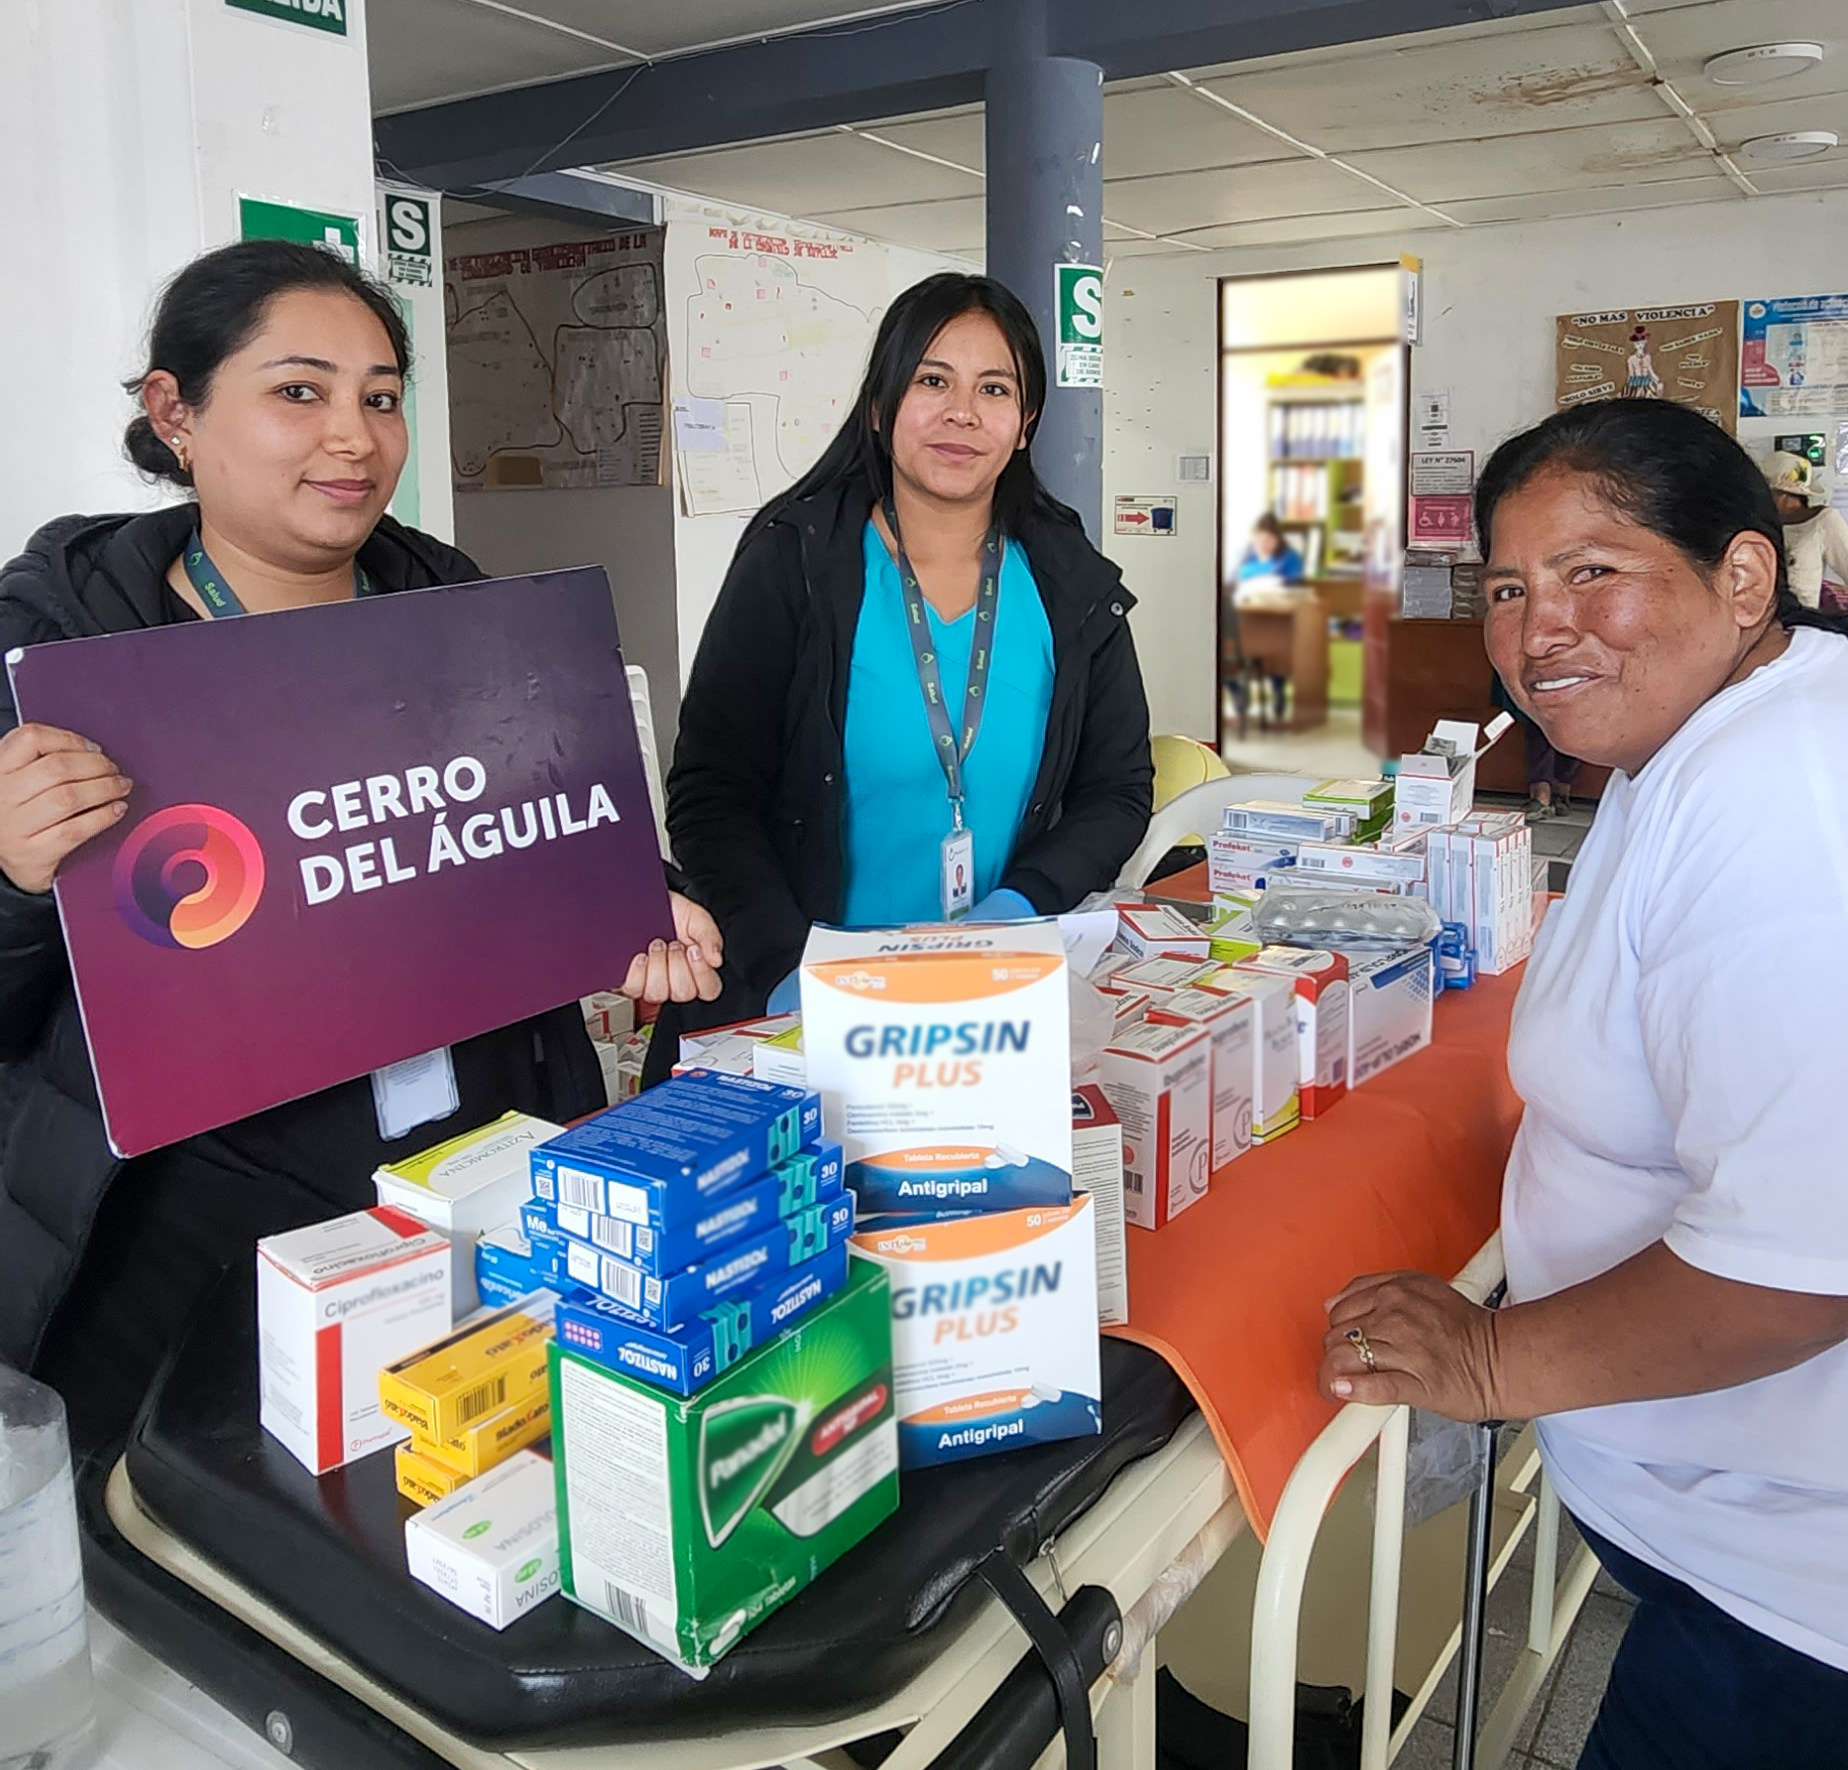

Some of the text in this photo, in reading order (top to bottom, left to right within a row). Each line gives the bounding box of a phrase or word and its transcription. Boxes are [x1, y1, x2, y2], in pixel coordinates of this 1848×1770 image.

[391, 201, 425, 250] S
[1071, 276, 1102, 338] S
[1600, 312, 1626, 324] MAS
[287, 756, 486, 838] CERRO
[300, 783, 620, 905] DEL ÁGUILA
[878, 940, 994, 952] GRIPSIN
[992, 969, 1008, 981] 50
[844, 1020, 1030, 1058] GRIPSIN
[893, 1060, 982, 1088] PLUS
[780, 1089, 804, 1099] 30
[803, 1107, 818, 1125] 30
[821, 1161, 838, 1179] 30
[903, 1153, 934, 1162] Tableta
[898, 1178, 988, 1198] Antigripal
[696, 1198, 758, 1239] NASTIZOL
[832, 1207, 848, 1226] 30
[1026, 1213, 1042, 1227] 50
[313, 1237, 426, 1275] Ciprofloxacino
[705, 1246, 768, 1290] NASTIZOL
[324, 1268, 445, 1319] Ciprofloxacino
[770, 1278, 822, 1325] NASTIZOL
[890, 1261, 1062, 1320] GRIPSIN
[932, 1307, 1019, 1346] PLUS
[617, 1346, 677, 1381] NASTIZOL
[693, 1356, 711, 1378] 30
[710, 1411, 786, 1489] Panadol
[938, 1418, 1024, 1449] Antigripal
